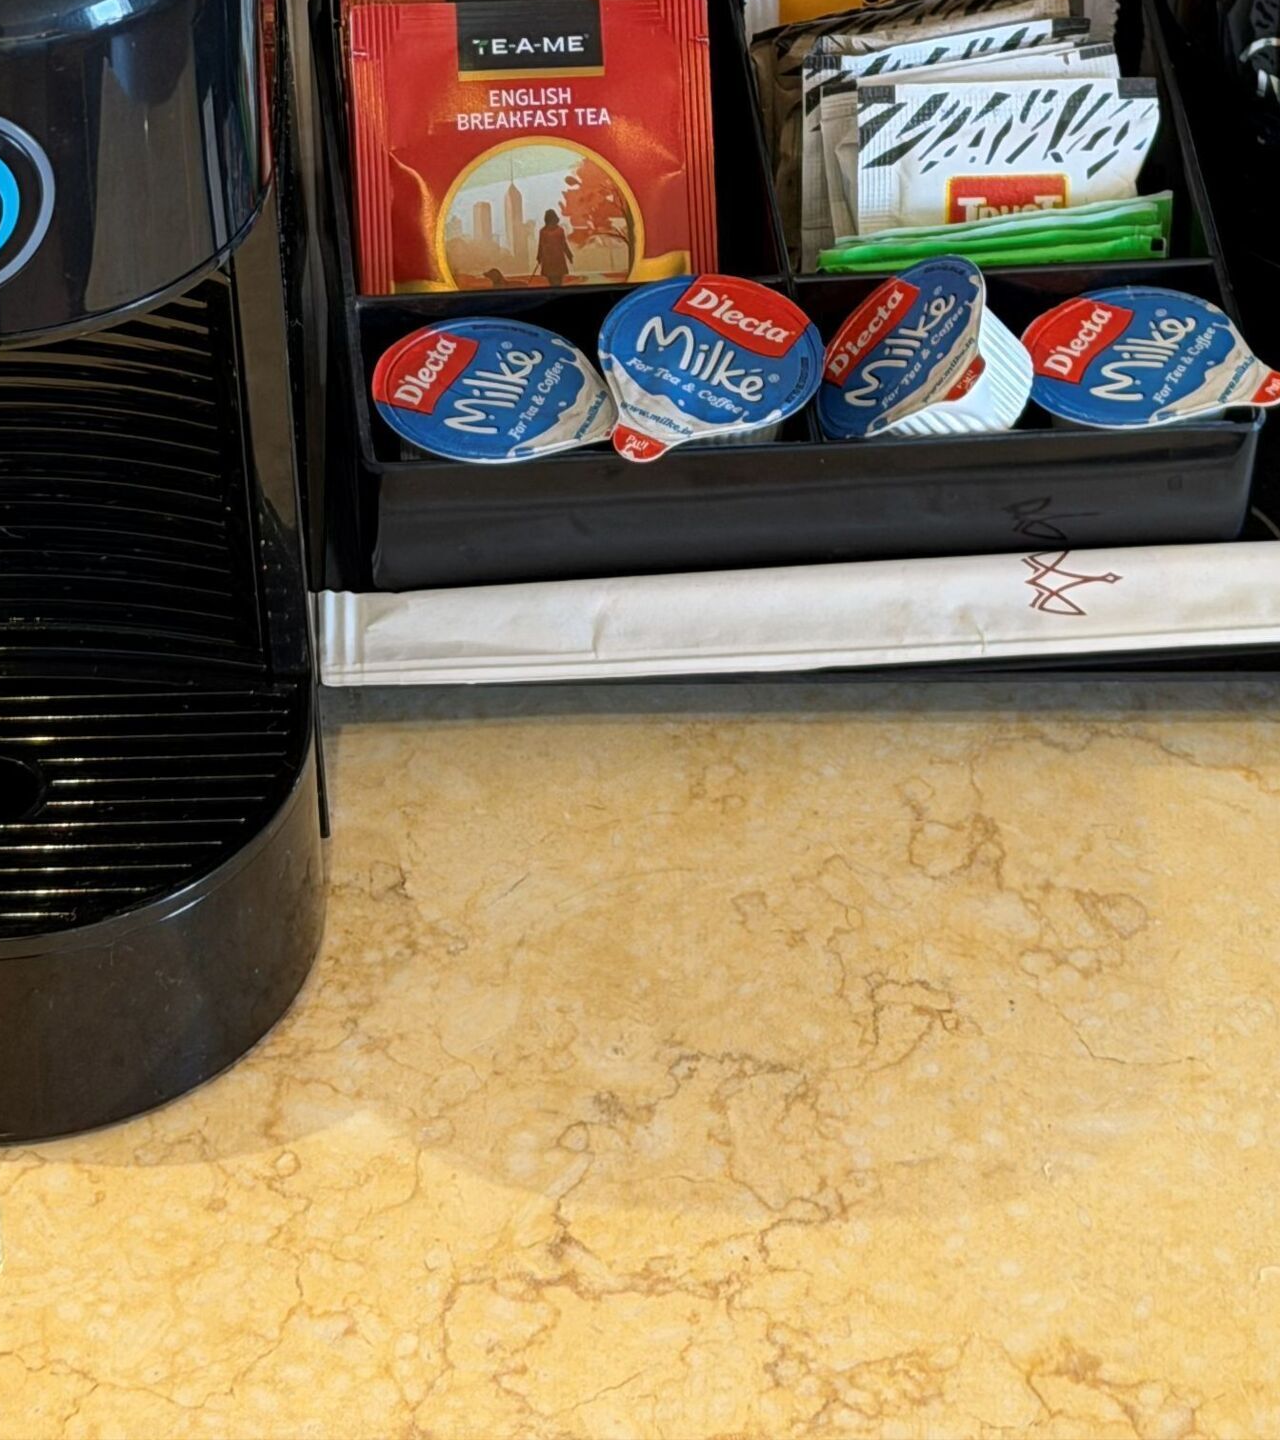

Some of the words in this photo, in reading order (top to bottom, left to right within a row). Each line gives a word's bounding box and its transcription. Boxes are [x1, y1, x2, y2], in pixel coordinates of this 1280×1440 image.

[489, 88, 571, 107] ENGLISH
[458, 110, 568, 131] BREAKFAST
[575, 108, 611, 126] TEA
[687, 288, 789, 343] D'lecta
[828, 286, 904, 376] D'lecta
[1044, 306, 1113, 376] D'lecta
[1188, 326, 1215, 356] Coffee
[901, 363, 922, 386] Tea
[931, 306, 964, 345] Coffee
[394, 336, 457, 405] D'lecta
[1184, 355, 1194, 366] &
[537, 361, 564, 394] Coffee
[626, 357, 652, 373] For
[656, 368, 680, 386] Tea
[682, 382, 695, 393] &
[698, 388, 744, 414] Coffee
[1166, 365, 1187, 389] Tea
[531, 394, 545, 407] &
[1152, 386, 1170, 404] For
[519, 403, 539, 427] Tea
[507, 420, 529, 440] For
